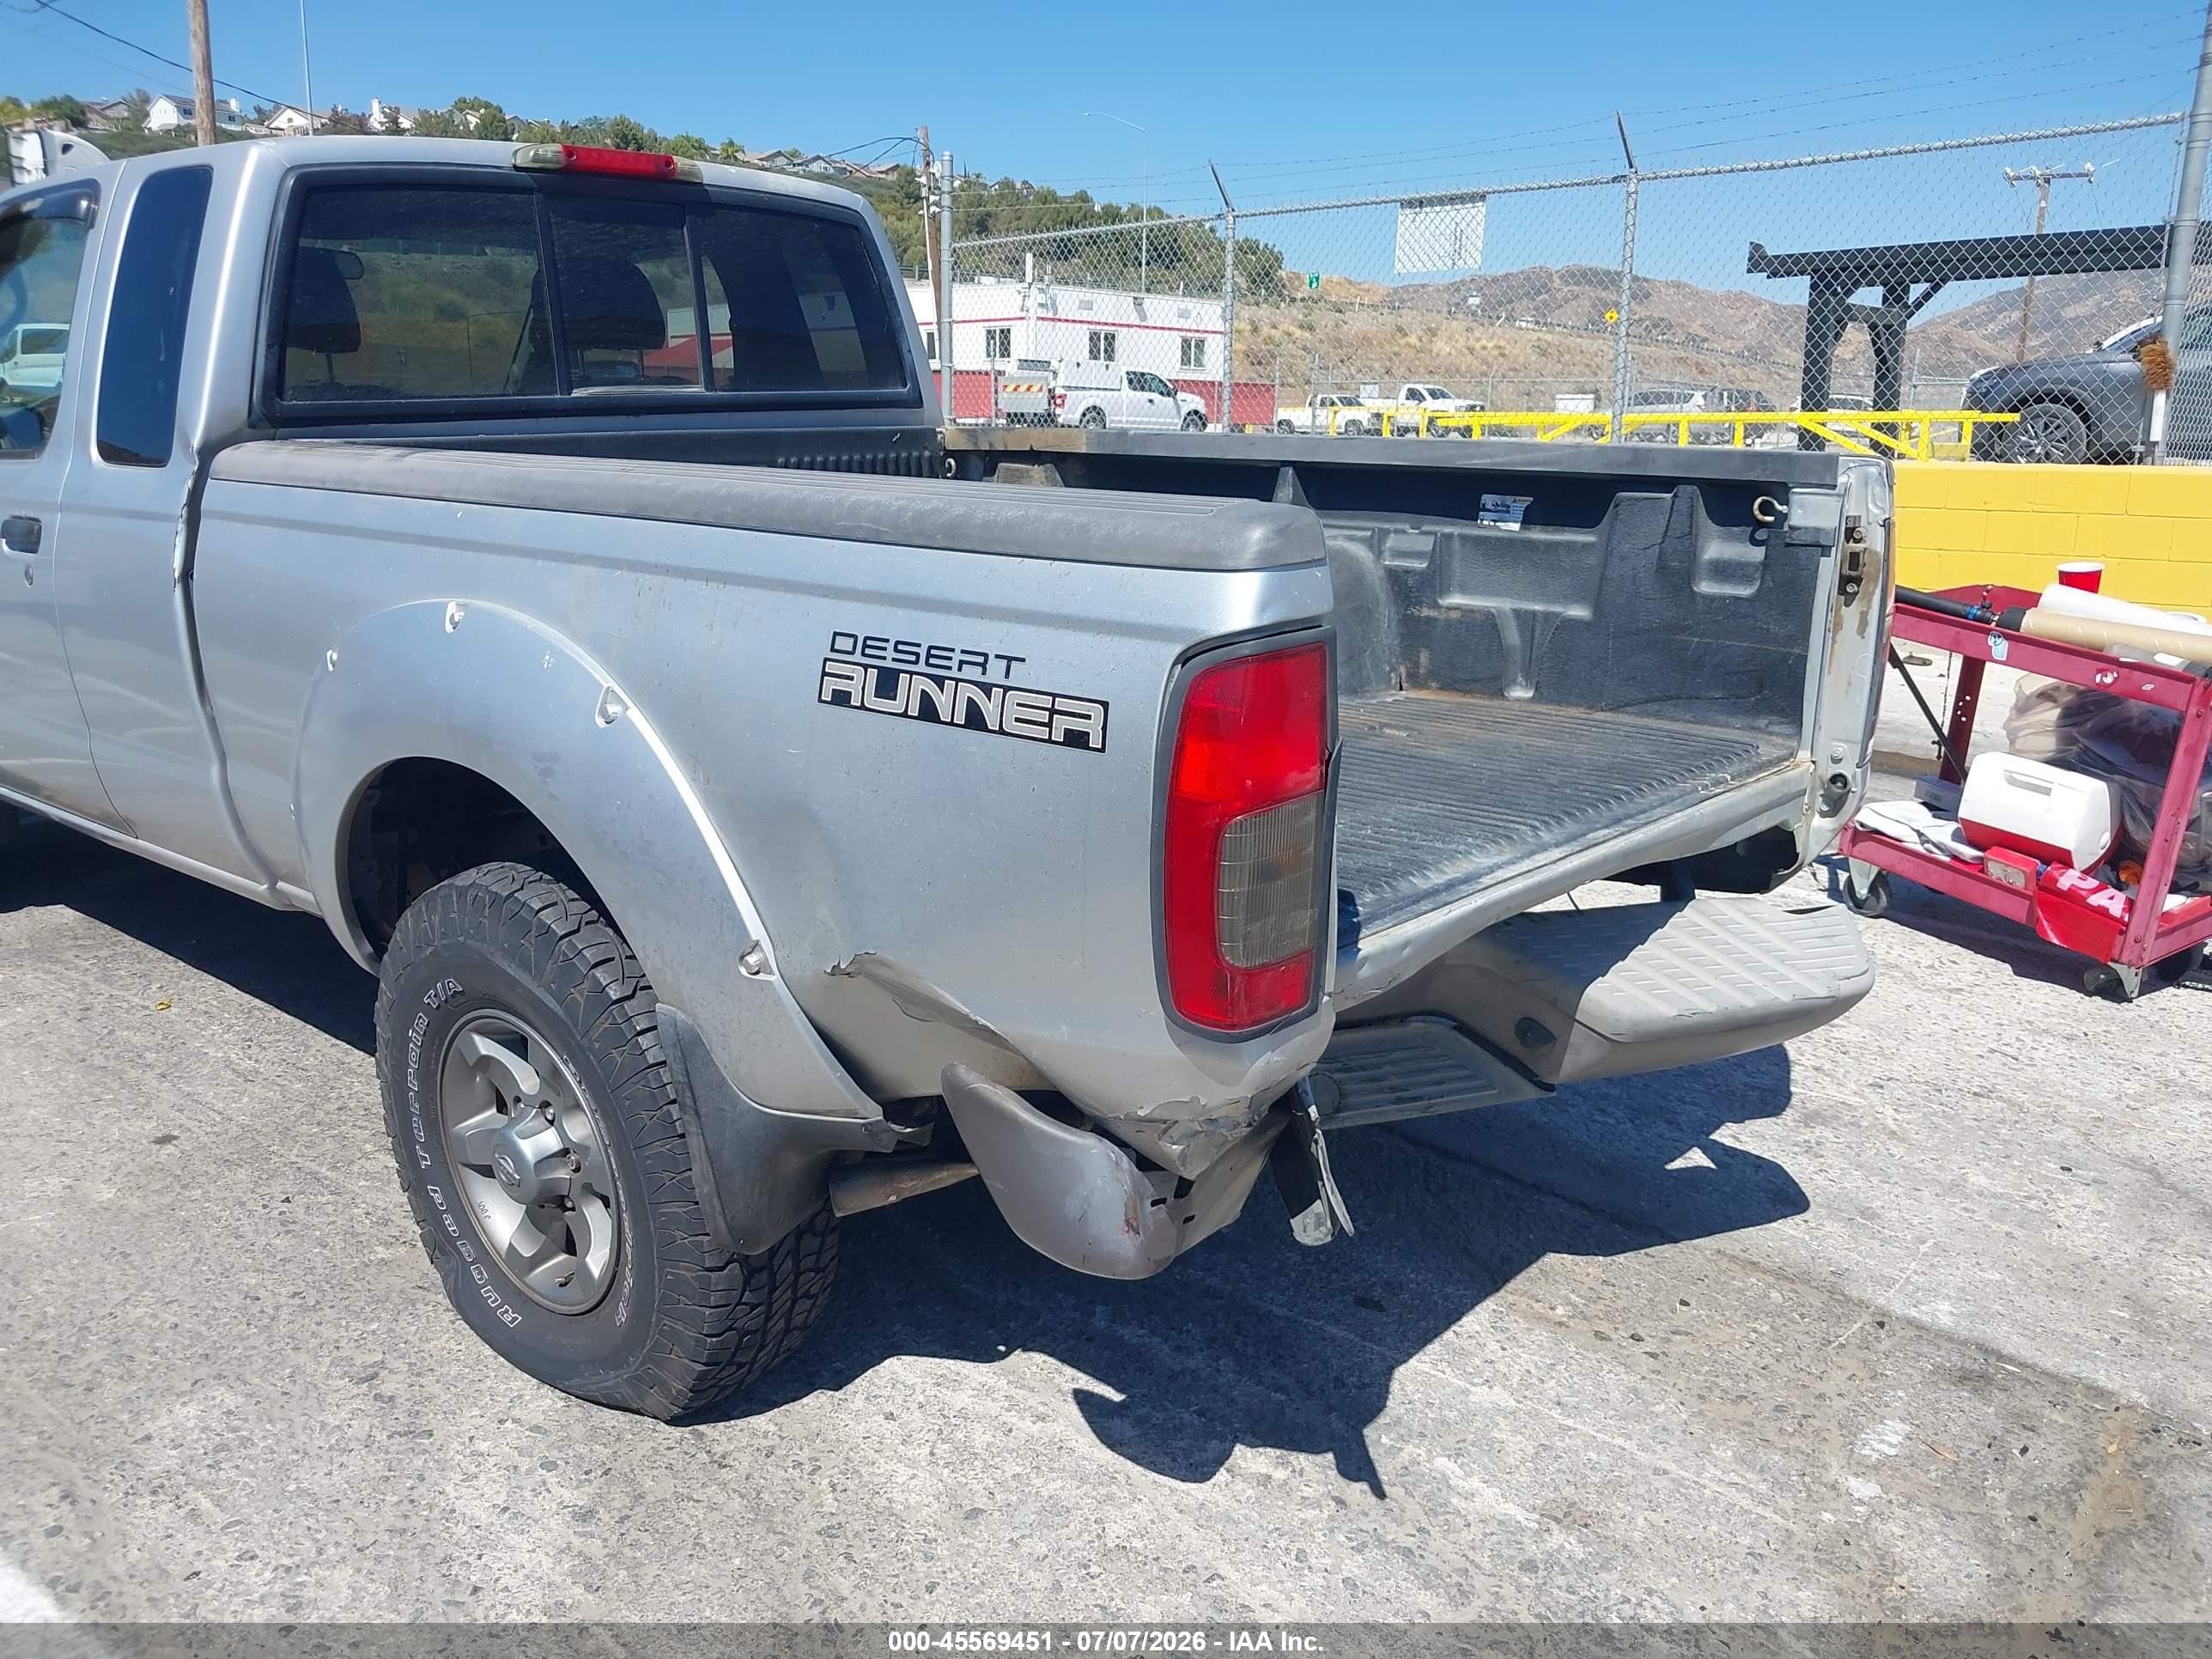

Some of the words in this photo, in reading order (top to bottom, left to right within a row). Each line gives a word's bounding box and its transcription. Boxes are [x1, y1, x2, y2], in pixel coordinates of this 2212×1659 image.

[830, 631, 1026, 680] DESERT
[821, 659, 1105, 750] RUNNER
[2056, 868, 2129, 922] PA
[423, 978, 463, 1008] T/A
[407, 1012, 431, 1169] Terrain
[427, 1184, 522, 1328] Rugged
